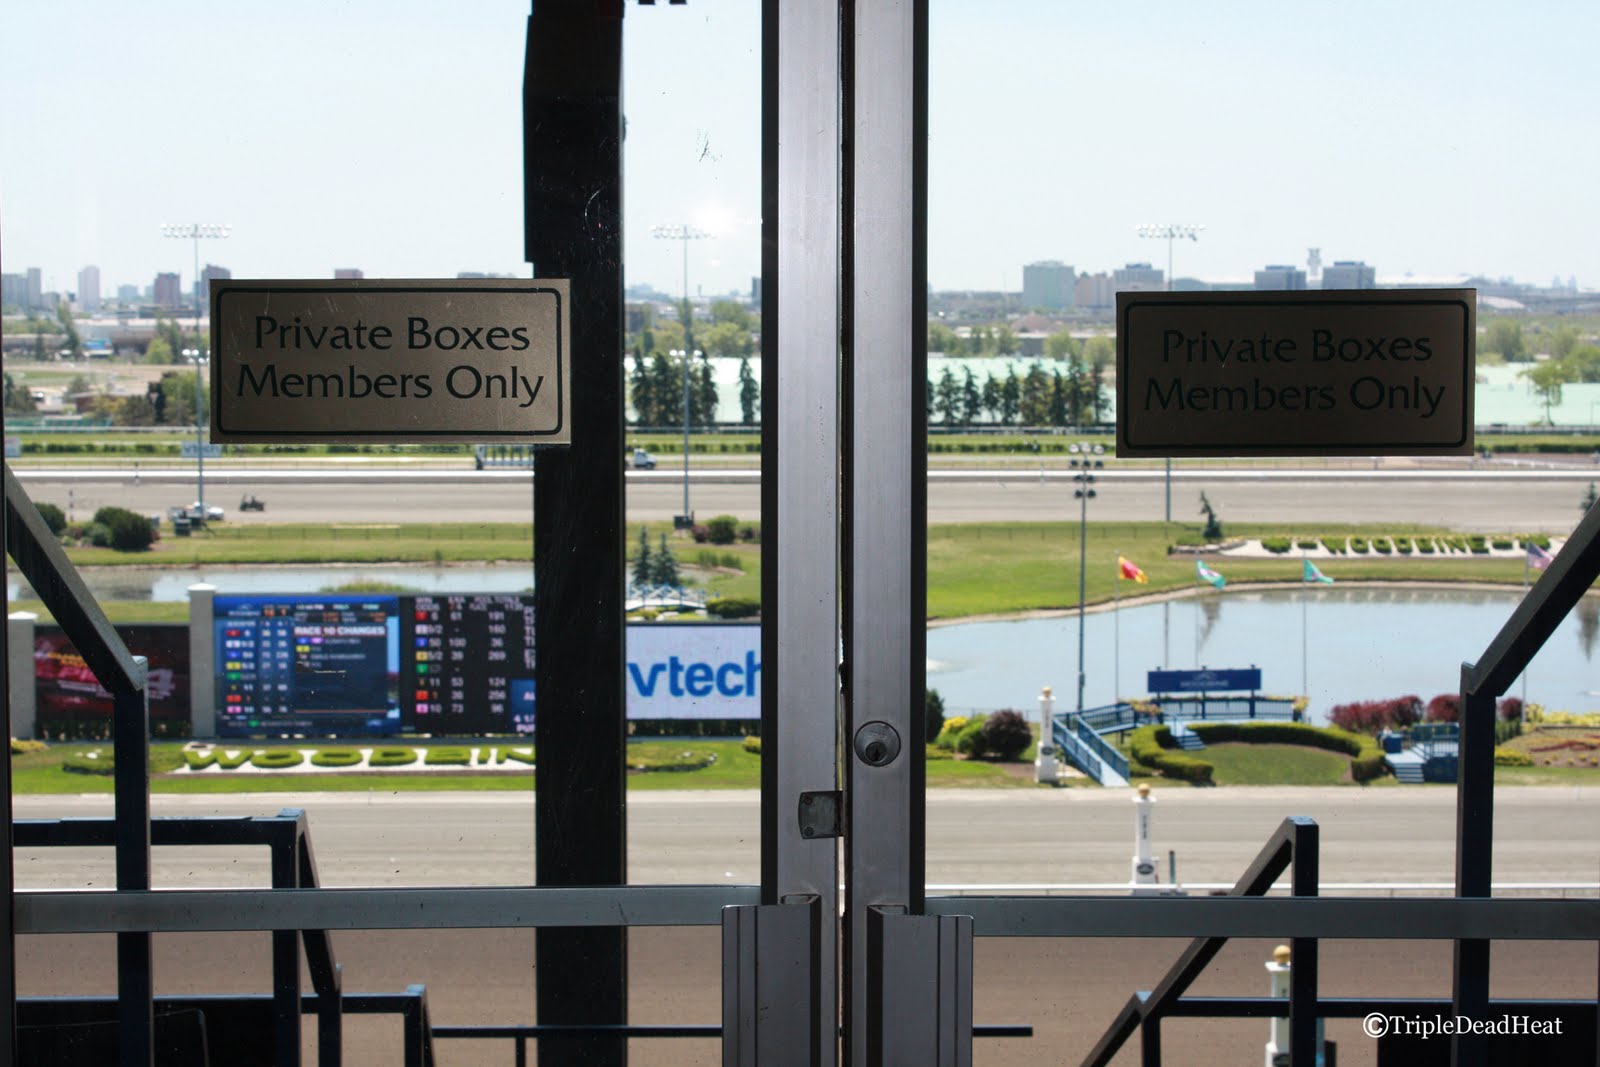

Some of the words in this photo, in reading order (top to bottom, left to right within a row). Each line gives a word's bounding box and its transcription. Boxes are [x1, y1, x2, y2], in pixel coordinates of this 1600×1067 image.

[255, 316, 393, 350] Private
[408, 317, 530, 351] Boxes
[1161, 329, 1298, 363] Private
[1312, 329, 1433, 362] Boxes
[236, 364, 433, 399] Members
[446, 366, 544, 408] Only
[1143, 377, 1337, 411] Members
[1350, 376, 1447, 418] Only
[294, 626, 322, 635] RACE
[337, 626, 385, 635] CHANGES
[628, 650, 761, 698] vtech
